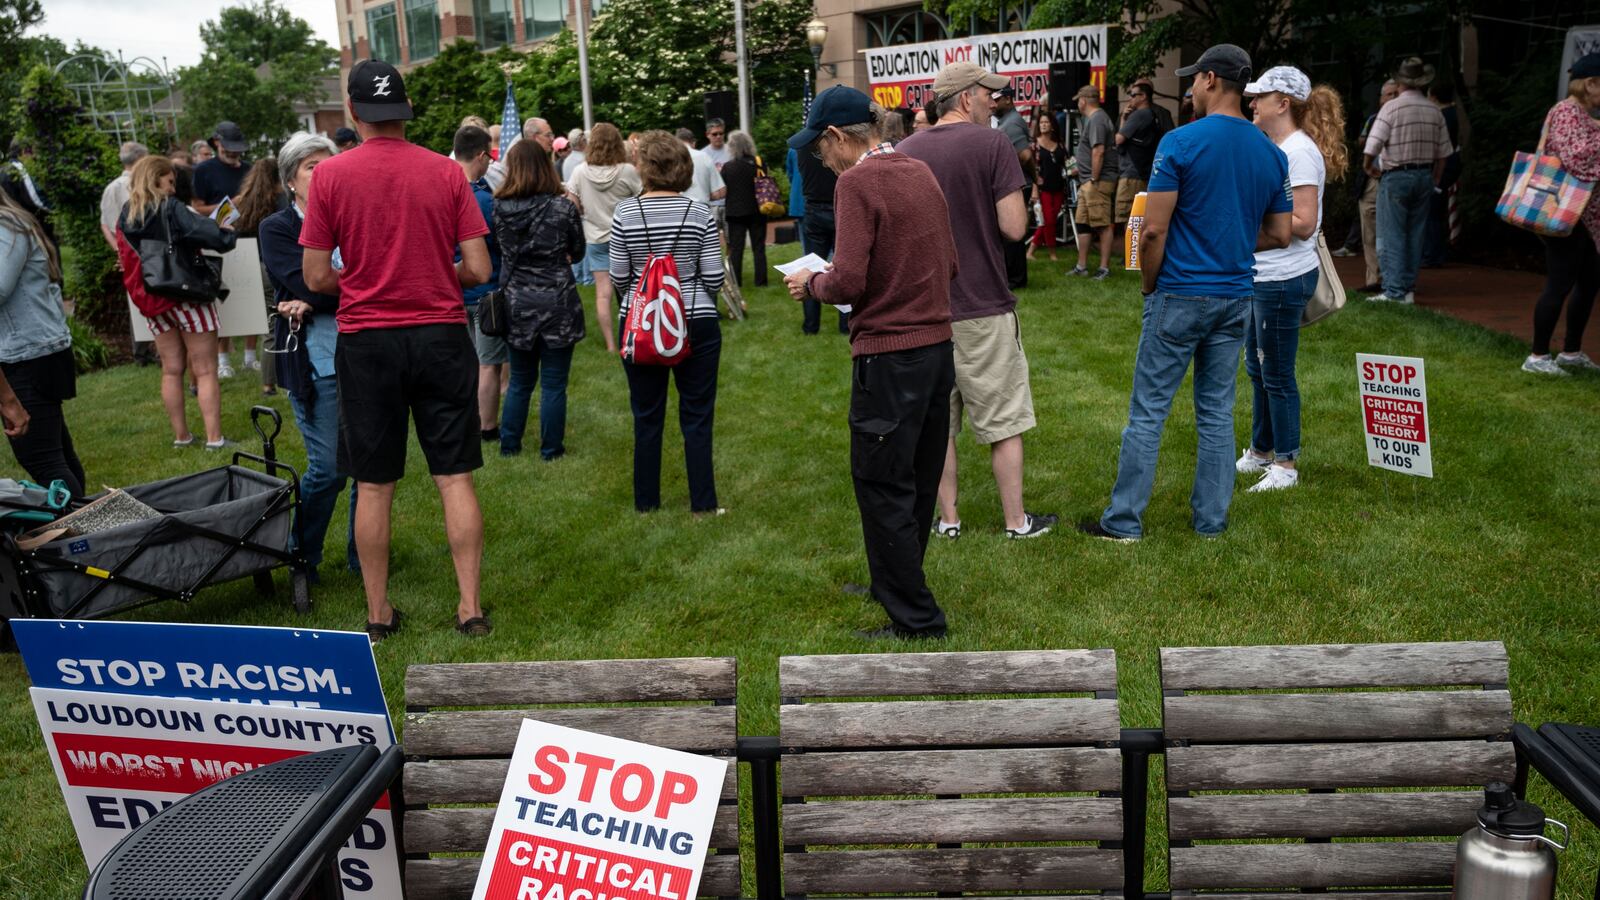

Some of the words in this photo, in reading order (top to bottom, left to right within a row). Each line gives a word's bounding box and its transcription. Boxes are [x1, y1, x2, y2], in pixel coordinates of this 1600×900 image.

[870, 49, 940, 78] EDUCATION
[944, 44, 973, 64] NOT
[978, 33, 1101, 67] INDOCTRINATION
[373, 75, 391, 96] Z
[873, 85, 902, 109] STOP
[1130, 217, 1140, 267] EDUCATION
[1363, 362, 1416, 385] STOP
[1362, 382, 1421, 398] TEACHING
[1366, 398, 1422, 414] CRITICAL
[1373, 411, 1416, 426] RACIST
[1373, 424, 1419, 440] THEORY
[1373, 437, 1389, 451] TO
[1392, 441, 1420, 456] OUR
[1383, 453, 1412, 469] KIDS
[56, 658, 165, 687] STOP
[177, 662, 352, 695] RACISM.
[47, 701, 205, 733] LOUDOUN
[66, 750, 184, 778] WORST
[528, 745, 698, 820] STOP
[514, 796, 695, 855] TEACHING
[508, 841, 679, 900] CRITICAL
